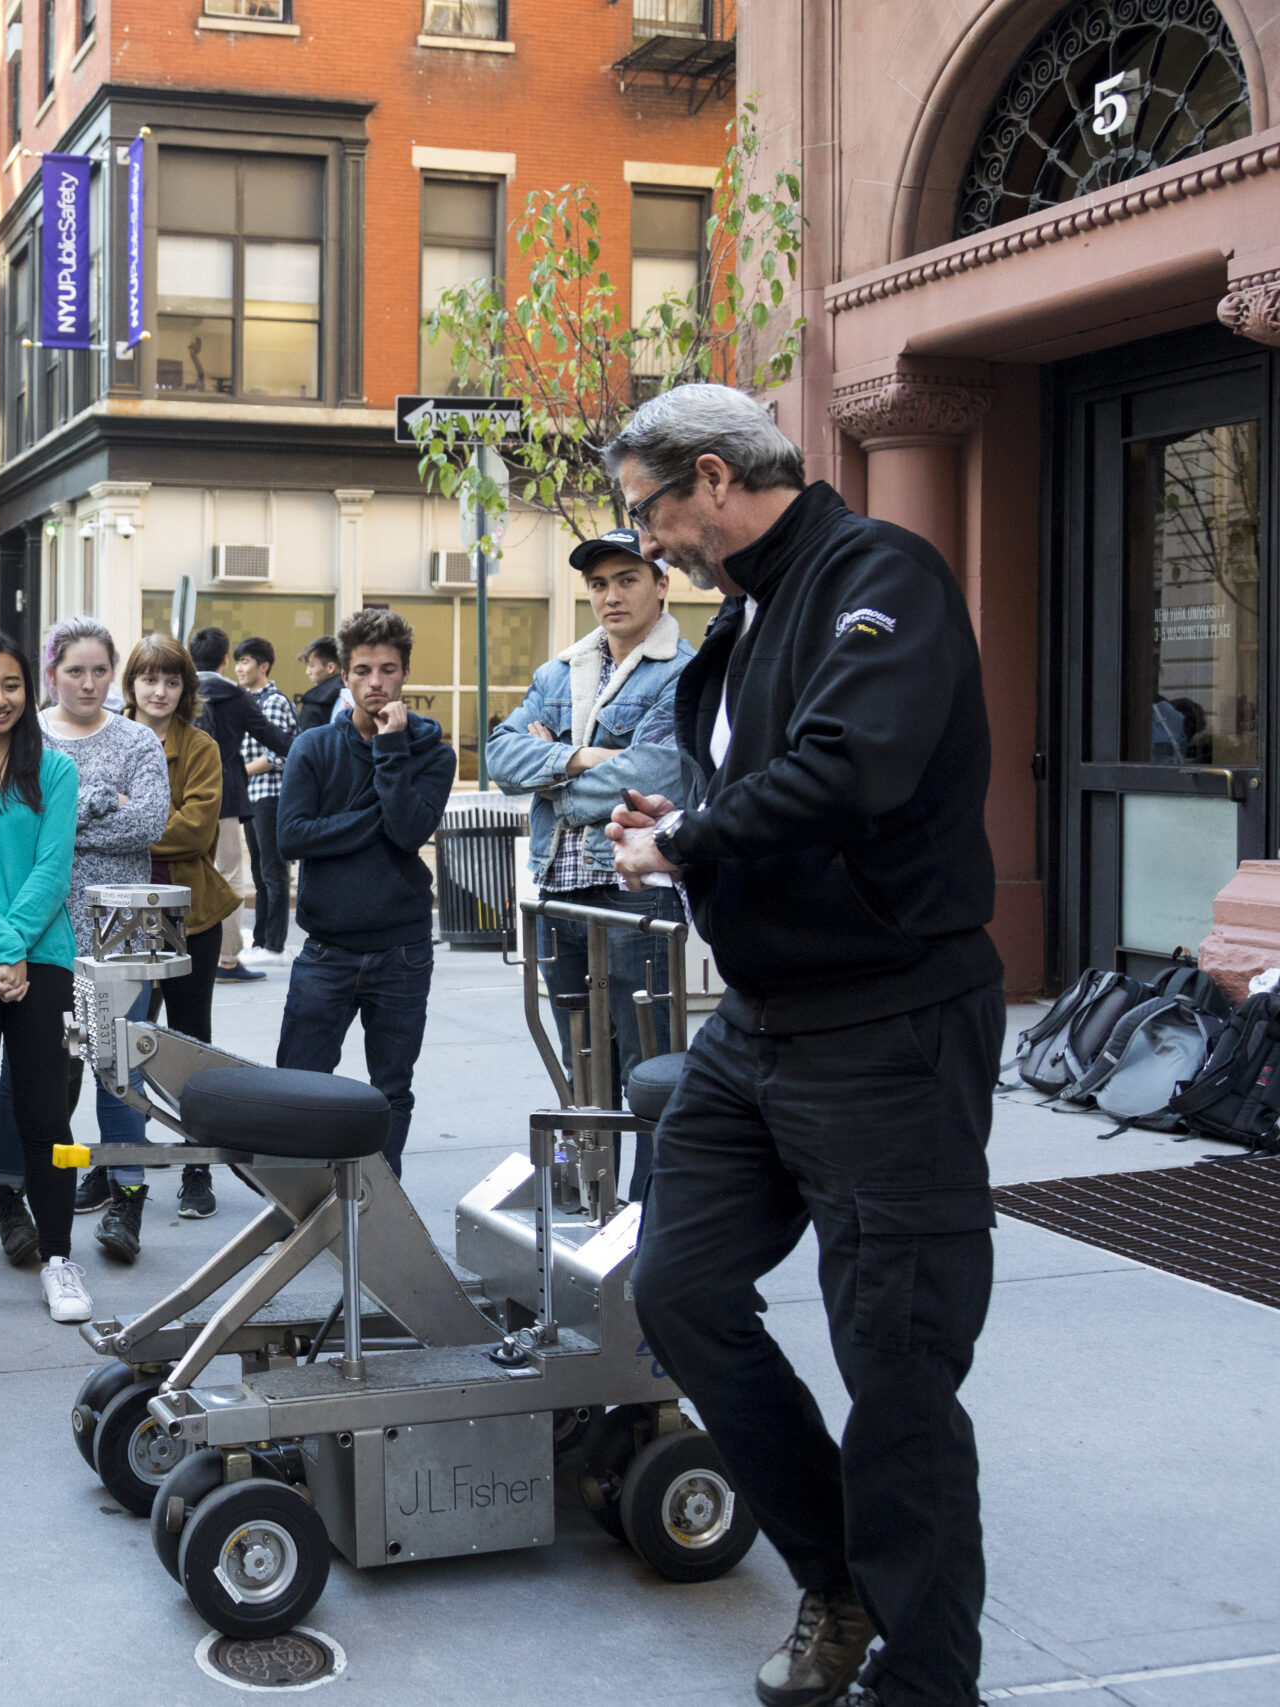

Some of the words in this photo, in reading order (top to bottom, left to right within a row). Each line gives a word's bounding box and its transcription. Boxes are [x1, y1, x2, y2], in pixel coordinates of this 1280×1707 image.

[1092, 71, 1129, 137] 5
[58, 171, 79, 333] NYUPublicSafety
[1154, 608, 1168, 622] NEW
[1170, 607, 1186, 621] YORK
[1187, 604, 1226, 620] UNIVERSITY
[1167, 625, 1209, 641] WASHINGTON
[1210, 623, 1231, 639] PLACE
[98, 992, 111, 1046] SLE-337
